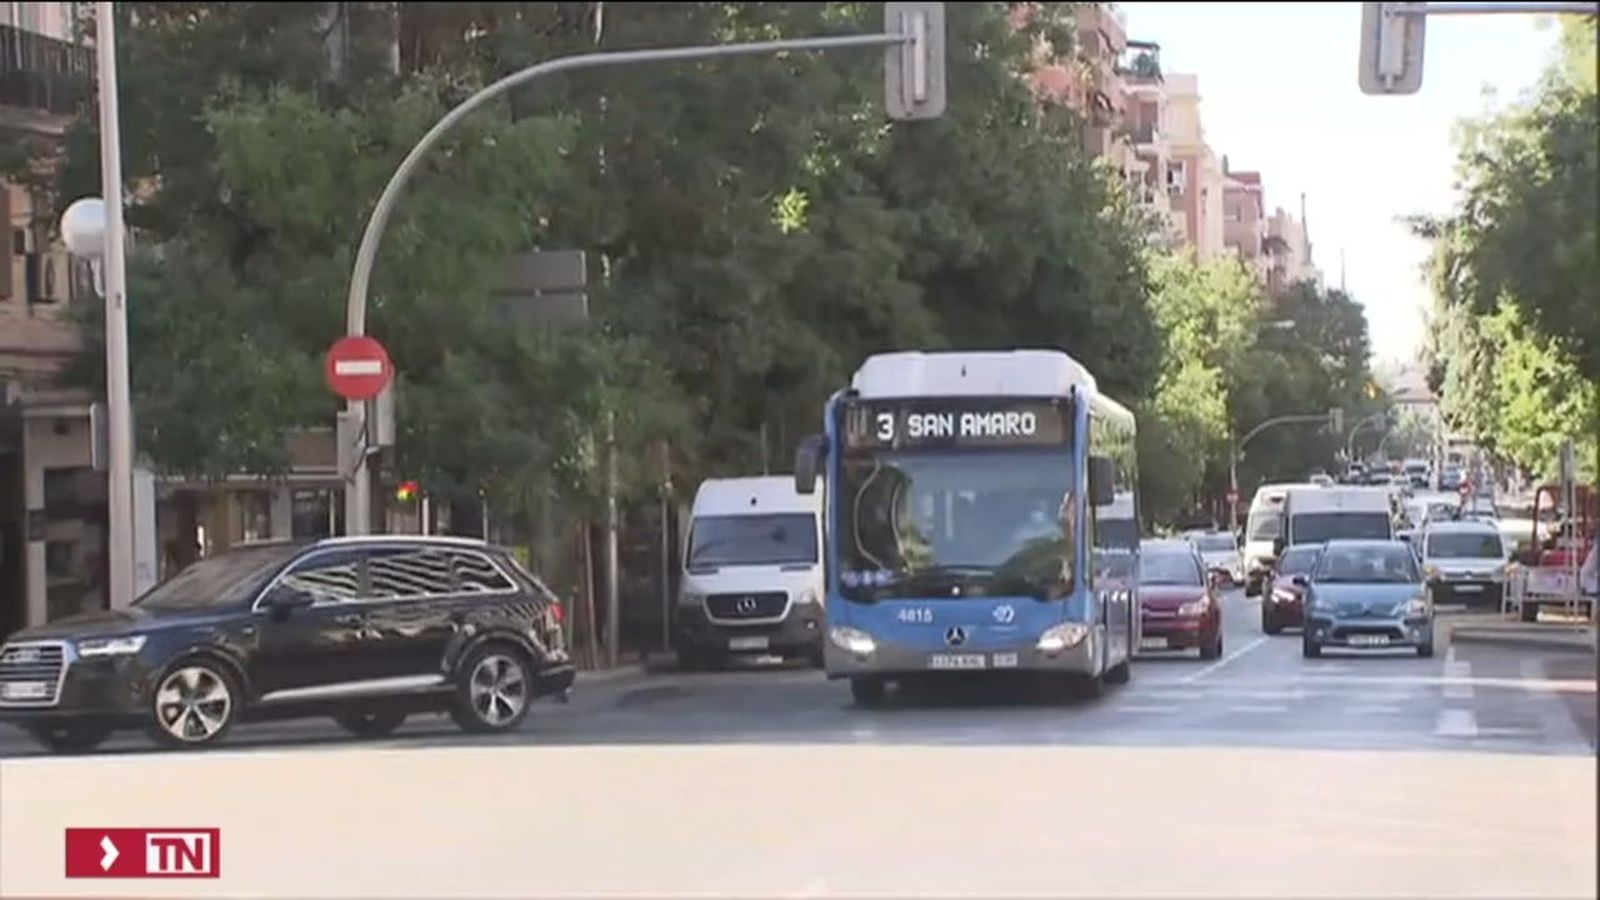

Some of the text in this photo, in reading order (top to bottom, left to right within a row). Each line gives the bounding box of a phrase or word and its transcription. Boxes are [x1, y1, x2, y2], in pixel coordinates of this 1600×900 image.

[876, 411, 1037, 441] 3 SAN AMARO
